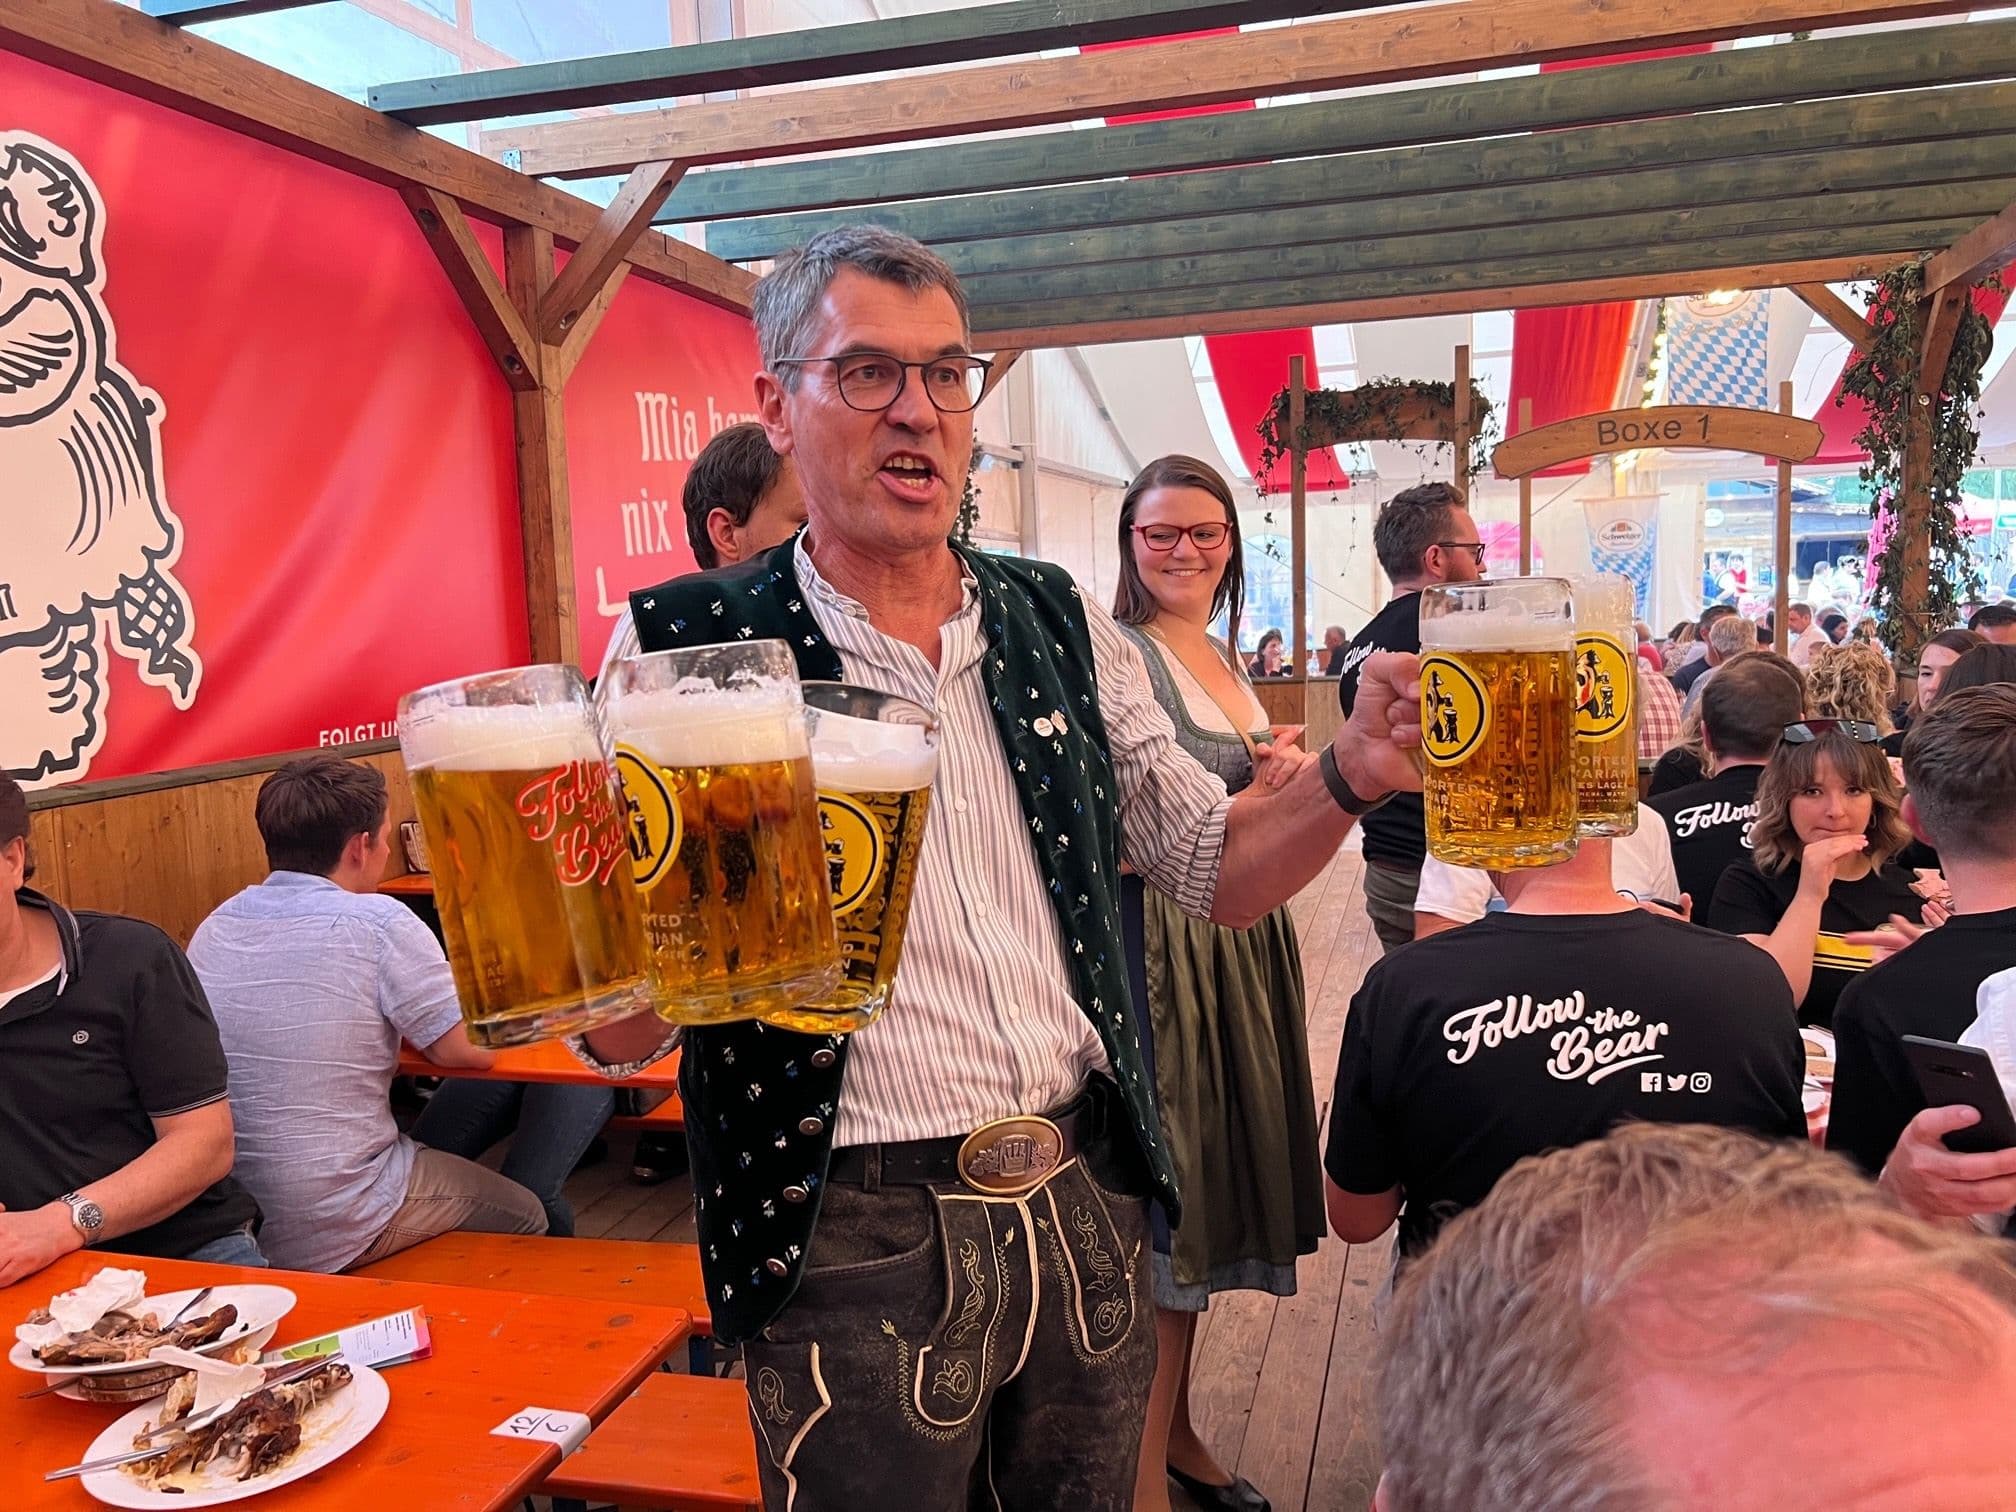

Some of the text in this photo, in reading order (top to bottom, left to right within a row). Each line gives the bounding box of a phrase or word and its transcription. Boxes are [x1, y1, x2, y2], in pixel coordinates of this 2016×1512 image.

[1597, 414, 1710, 445] Boxe 1
[621, 487, 672, 557] nix
[319, 723, 377, 748] FOLGT
[1578, 755, 1628, 766] ORTED
[1674, 801, 1761, 837] Follow
[1443, 990, 1641, 1064] Follow the
[1546, 1021, 1669, 1081] Bear
